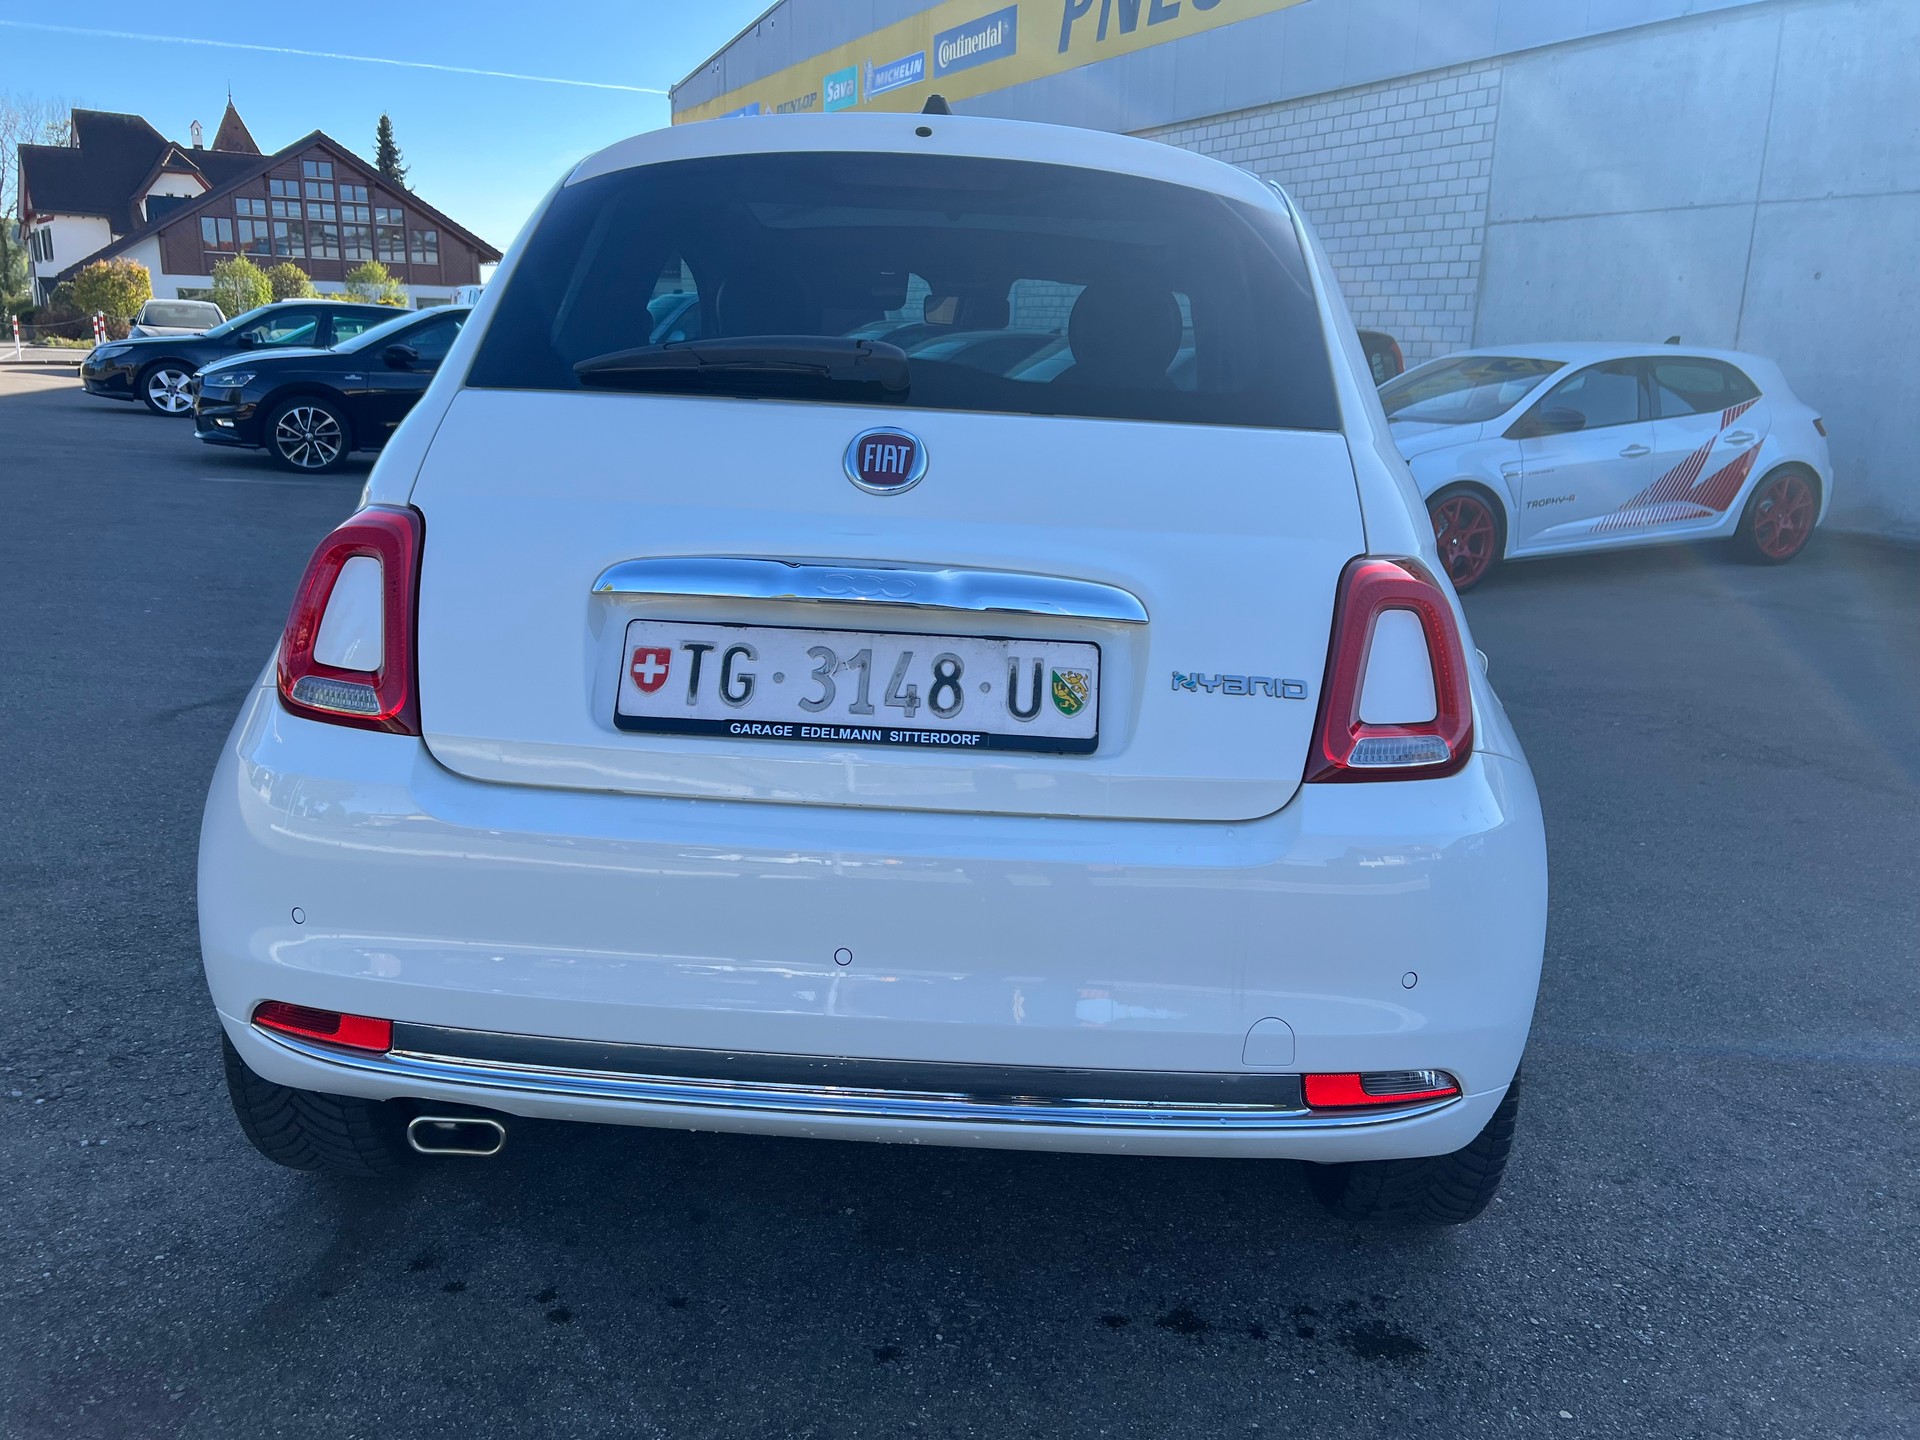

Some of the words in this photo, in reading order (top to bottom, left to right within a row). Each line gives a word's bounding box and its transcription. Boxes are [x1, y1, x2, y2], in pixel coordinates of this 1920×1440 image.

[1057, 0, 1222, 54] PN
[938, 21, 1002, 68] Continental
[875, 58, 923, 87] MICHELIN
[776, 92, 817, 114] DUNLOP
[827, 79, 854, 103] Sava
[863, 443, 911, 474] FIAT
[798, 645, 964, 719] 3148
[1171, 671, 1309, 700] HYBRID
[729, 722, 794, 737] GARAGE
[801, 726, 882, 741] EDELMANN
[889, 730, 981, 746] SITTERDORF
